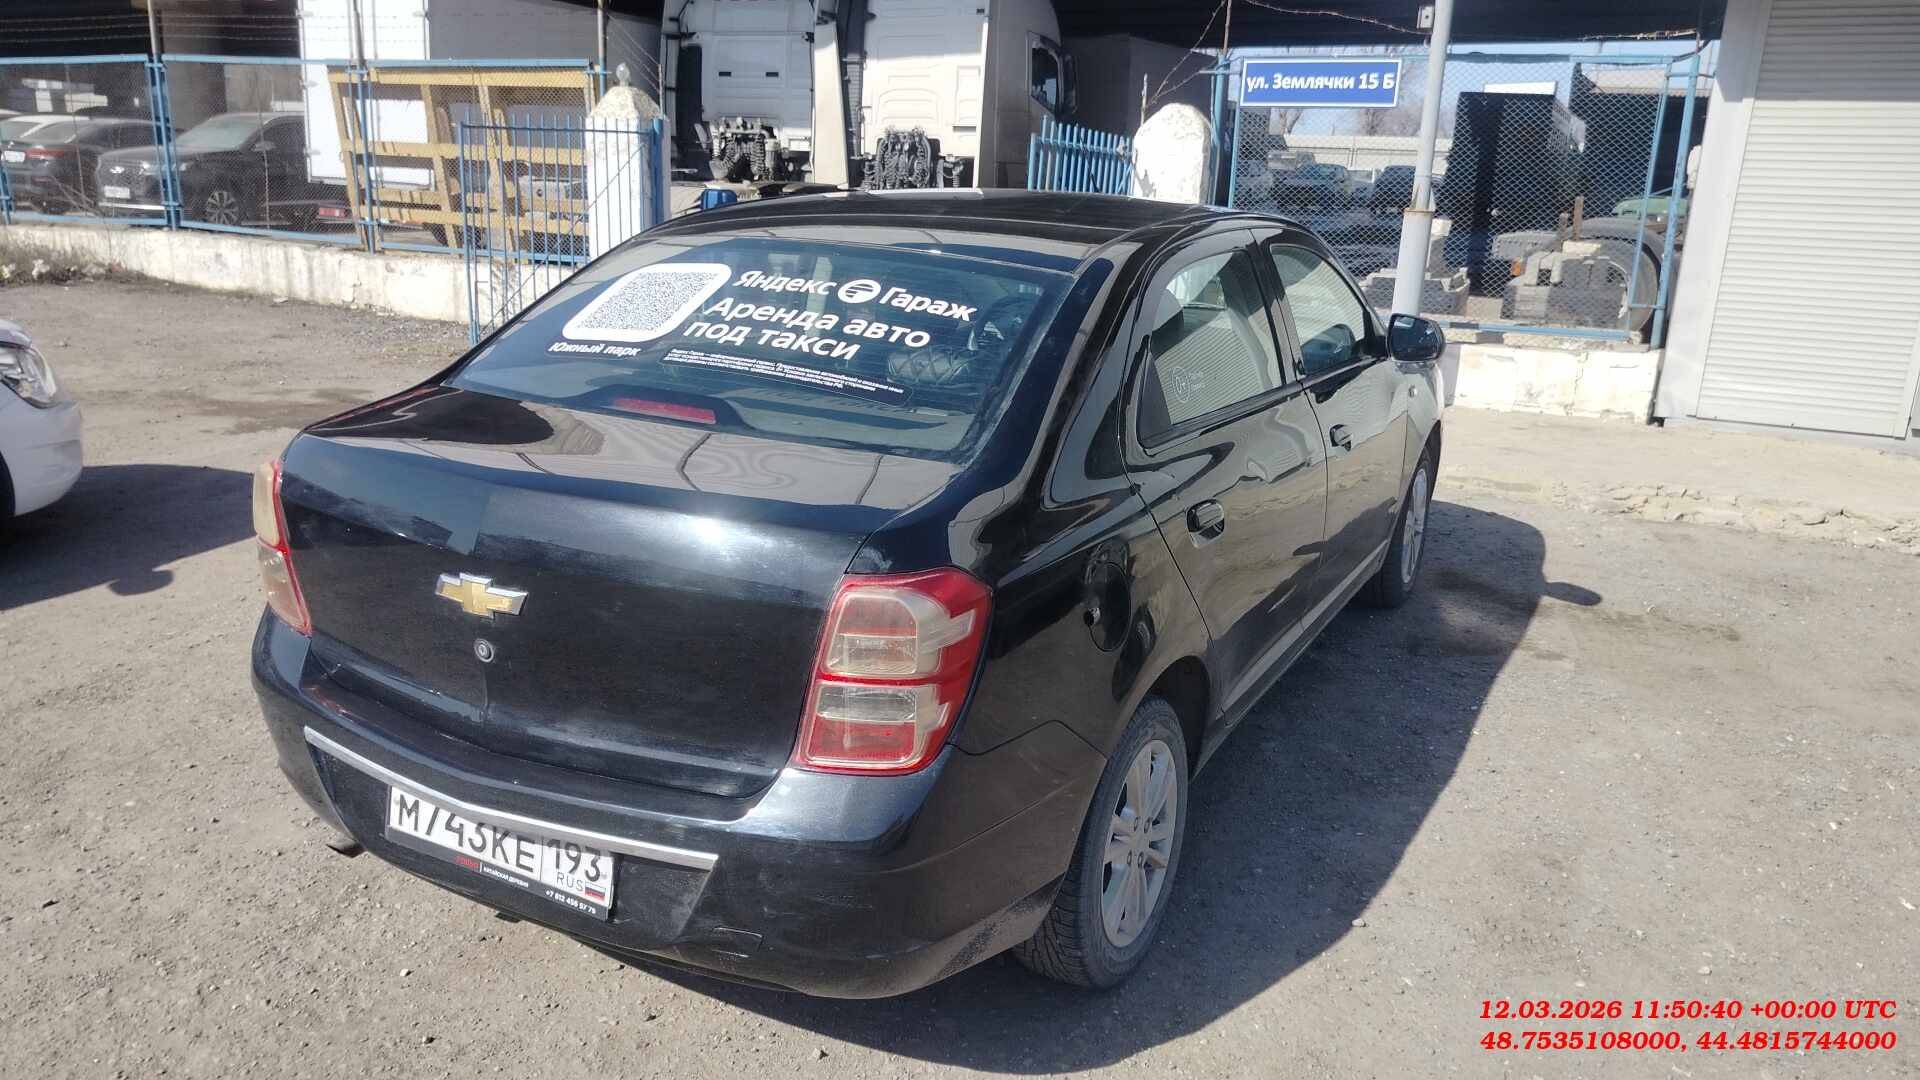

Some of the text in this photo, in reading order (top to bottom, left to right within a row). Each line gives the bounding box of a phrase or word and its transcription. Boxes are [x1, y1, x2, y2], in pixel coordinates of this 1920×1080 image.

[1247, 73, 1395, 92] ул. Землячки 15 Б
[733, 270, 977, 321] Яндекс Гараж
[683, 321, 861, 360] под такси
[703, 297, 931, 348] Аренда авто
[548, 342, 641, 357] Южный парк
[547, 838, 601, 882] 193
[556, 871, 584, 892] RUS
